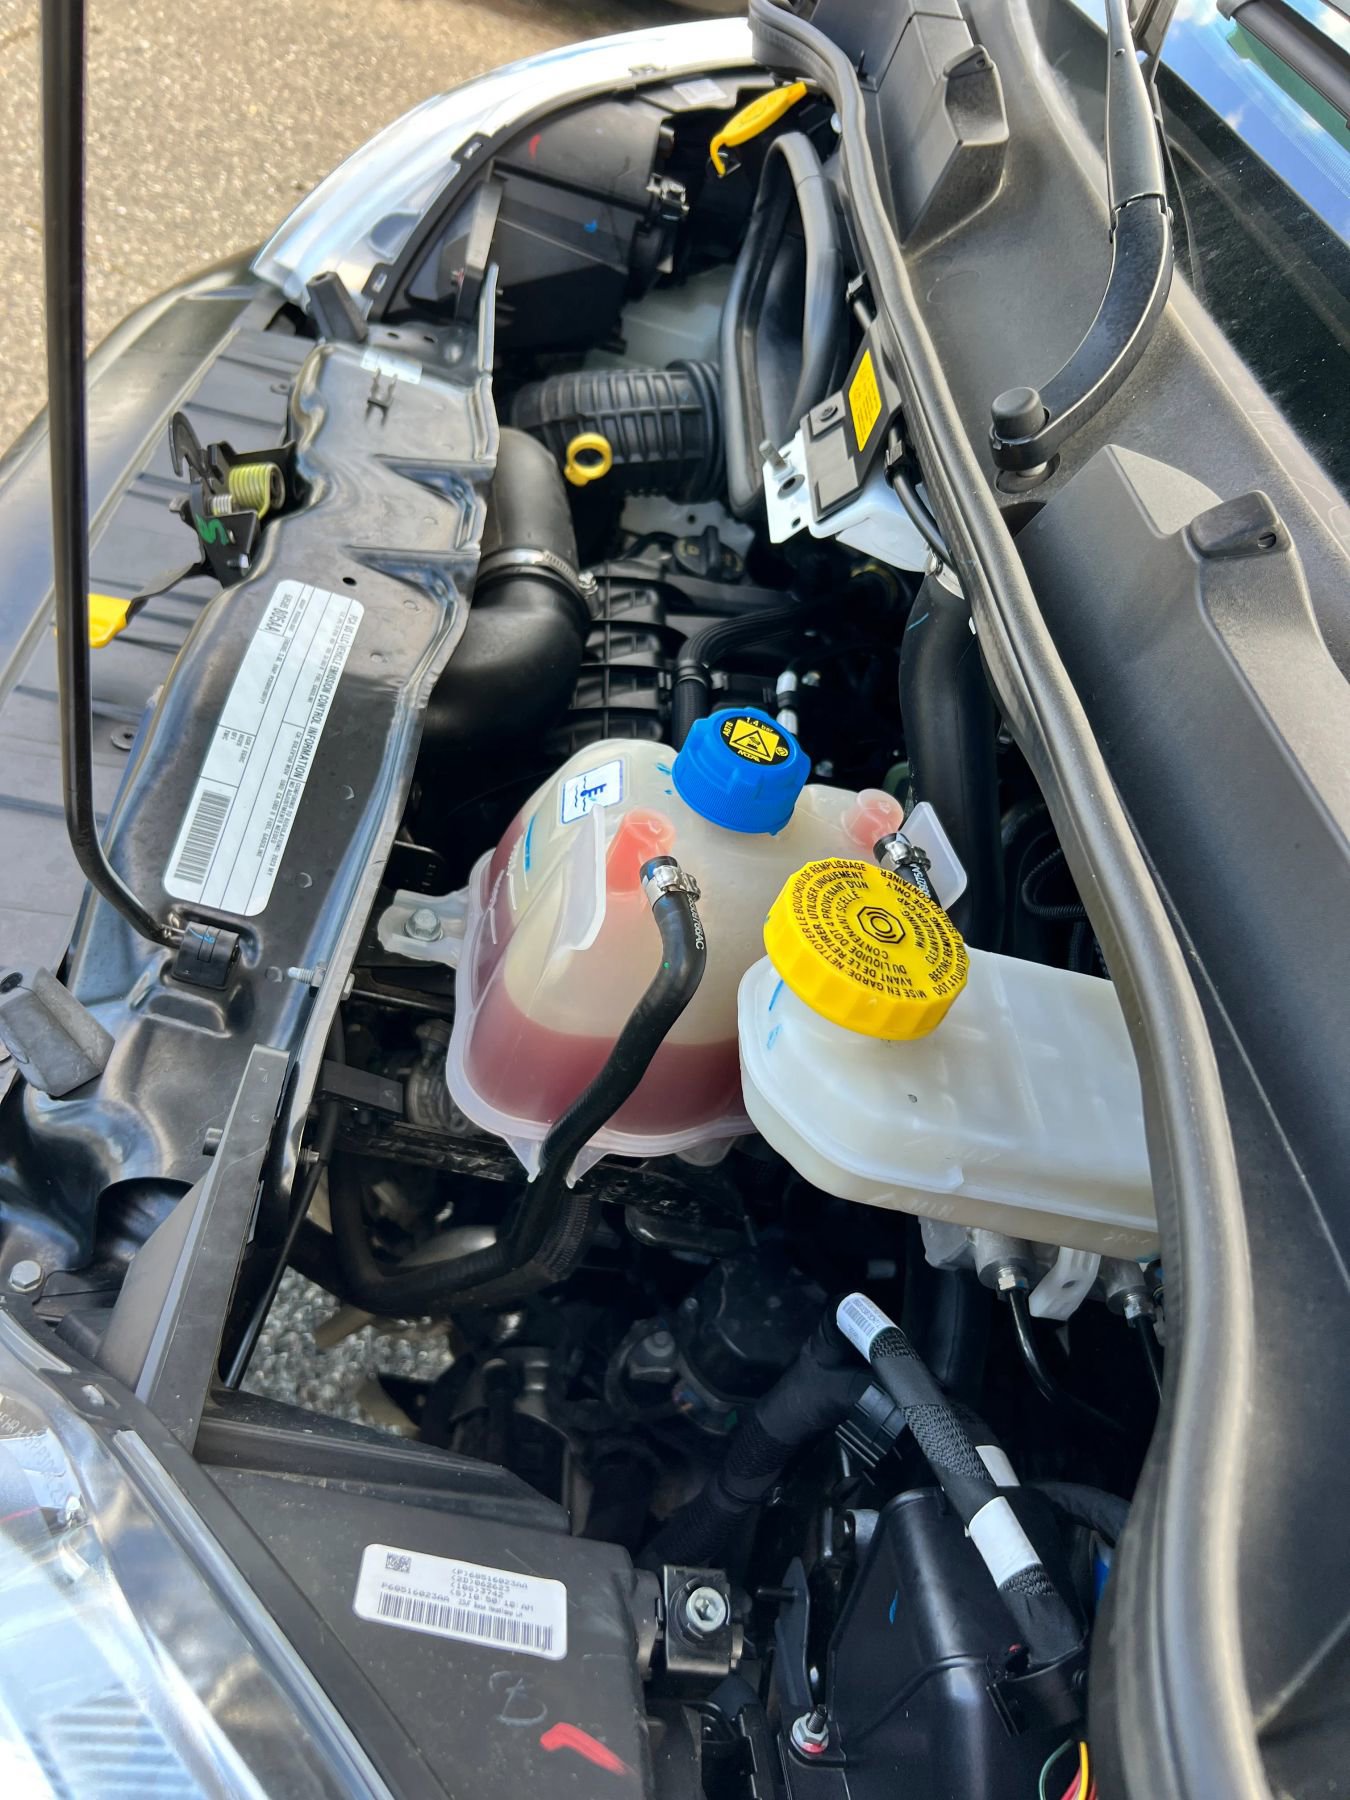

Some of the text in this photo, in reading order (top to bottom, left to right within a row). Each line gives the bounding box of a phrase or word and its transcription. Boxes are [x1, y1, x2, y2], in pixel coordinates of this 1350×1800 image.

[331, 644, 346, 665] VEHICLE
[321, 665, 339, 694] EMISSION
[310, 693, 328, 726] CONTROL
[292, 726, 317, 779] INFORMATION
[800, 870, 814, 882] DE
[809, 860, 868, 874] REMPLISSAGE
[813, 870, 864, 889] UNIQUEMENT
[792, 877, 808, 914] BOUCHON
[886, 881, 911, 898] ONLY
[807, 886, 819, 919] UTILISER
[820, 881, 847, 919] PROVENANT
[912, 898, 930, 914] USE
[796, 915, 809, 926] LE
[830, 929, 849, 947] DOT
[836, 913, 889, 960] CONTENANT
[897, 897, 939, 965] CLEAN FILLER CAP
[802, 927, 845, 970] NETTOYER
[848, 945, 890, 971] LIQUIDE
[955, 942, 967, 963] FROM
[847, 957, 861, 969] LE
[863, 965, 877, 978] DE
[892, 964, 907, 974] DU
[928, 960, 952, 982] BEFORE
[950, 963, 967, 982] FLUID
[880, 973, 912, 986] AVANT
[932, 982, 950, 995] DOT
[886, 985, 900, 996] EN
[903, 988, 927, 998] MISE
